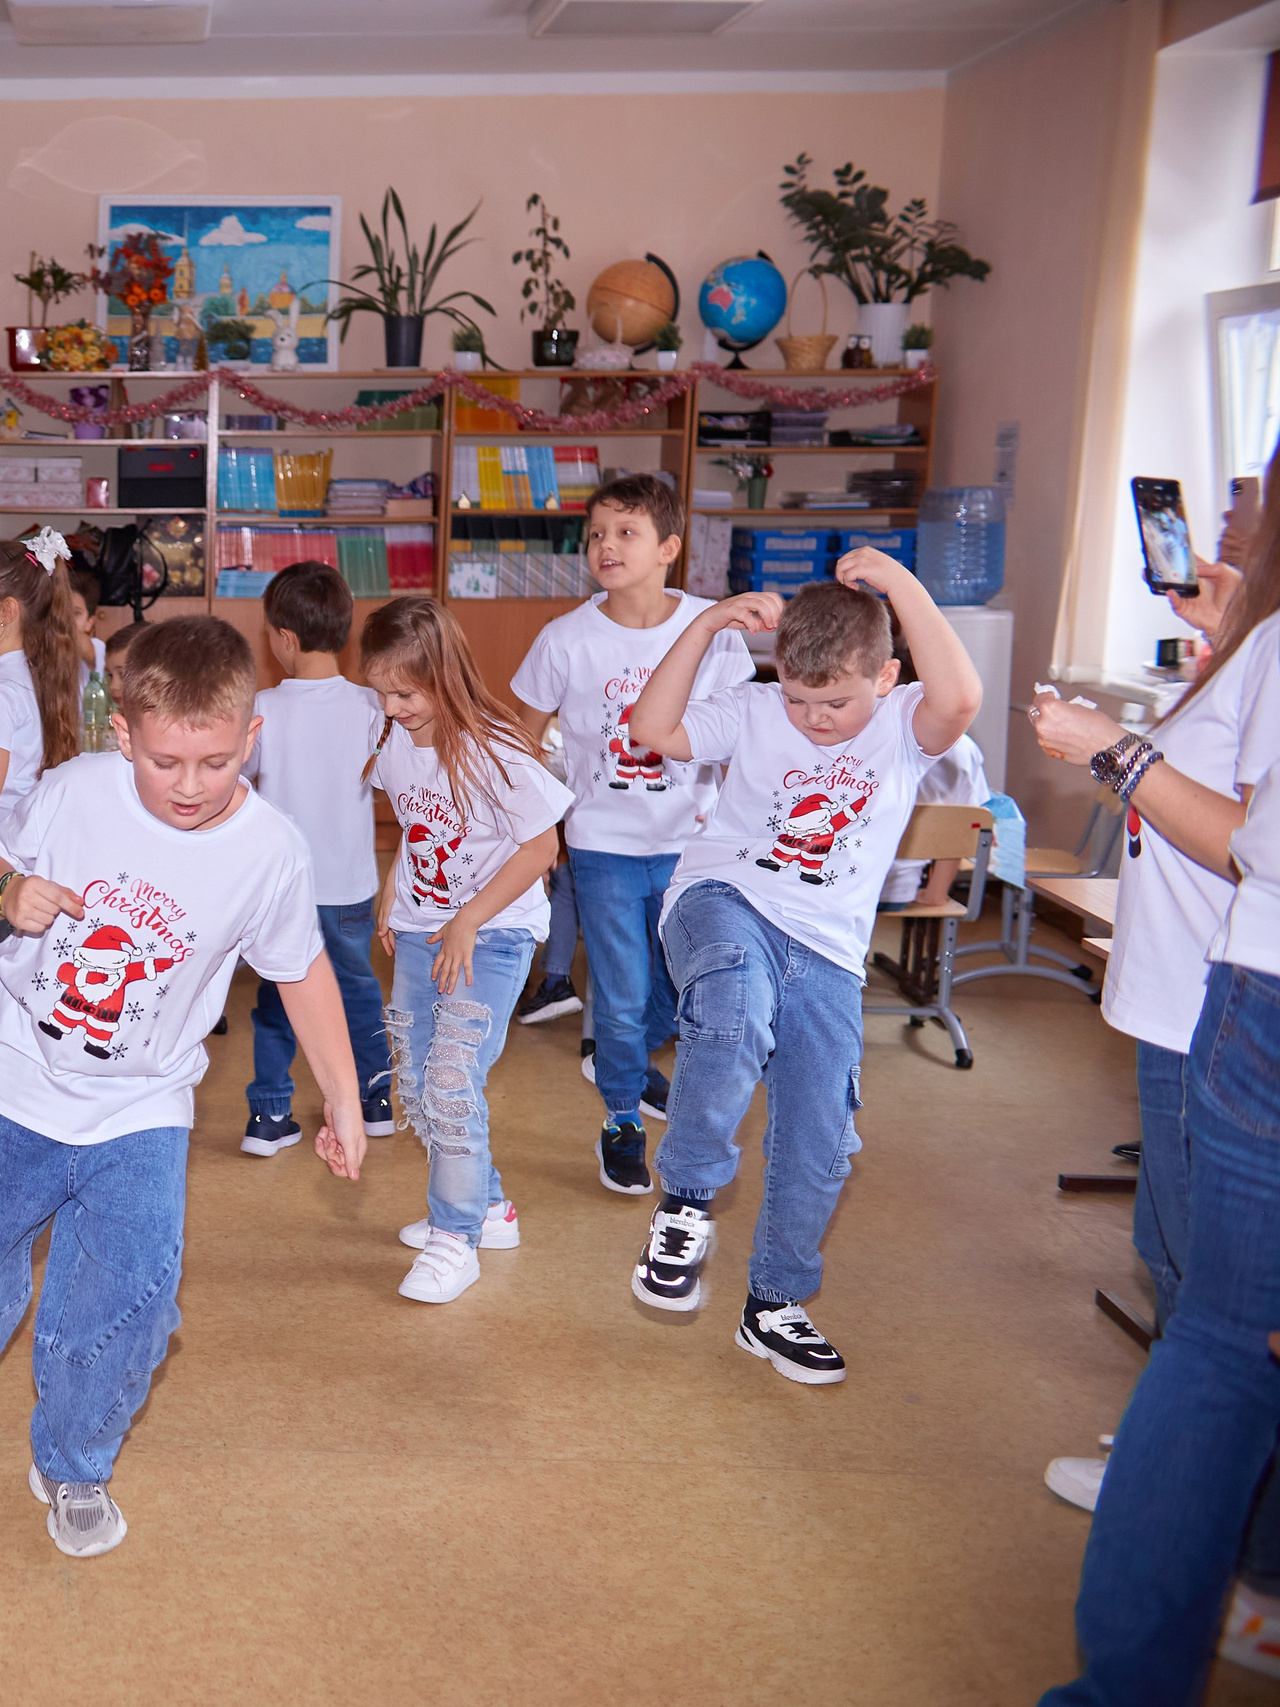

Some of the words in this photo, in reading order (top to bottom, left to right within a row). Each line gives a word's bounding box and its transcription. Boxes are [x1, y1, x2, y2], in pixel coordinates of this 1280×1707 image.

[398, 793, 473, 838] Christmas
[418, 787, 456, 812] Merry
[83, 879, 195, 963] Christmas
[130, 878, 187, 922] Merry
